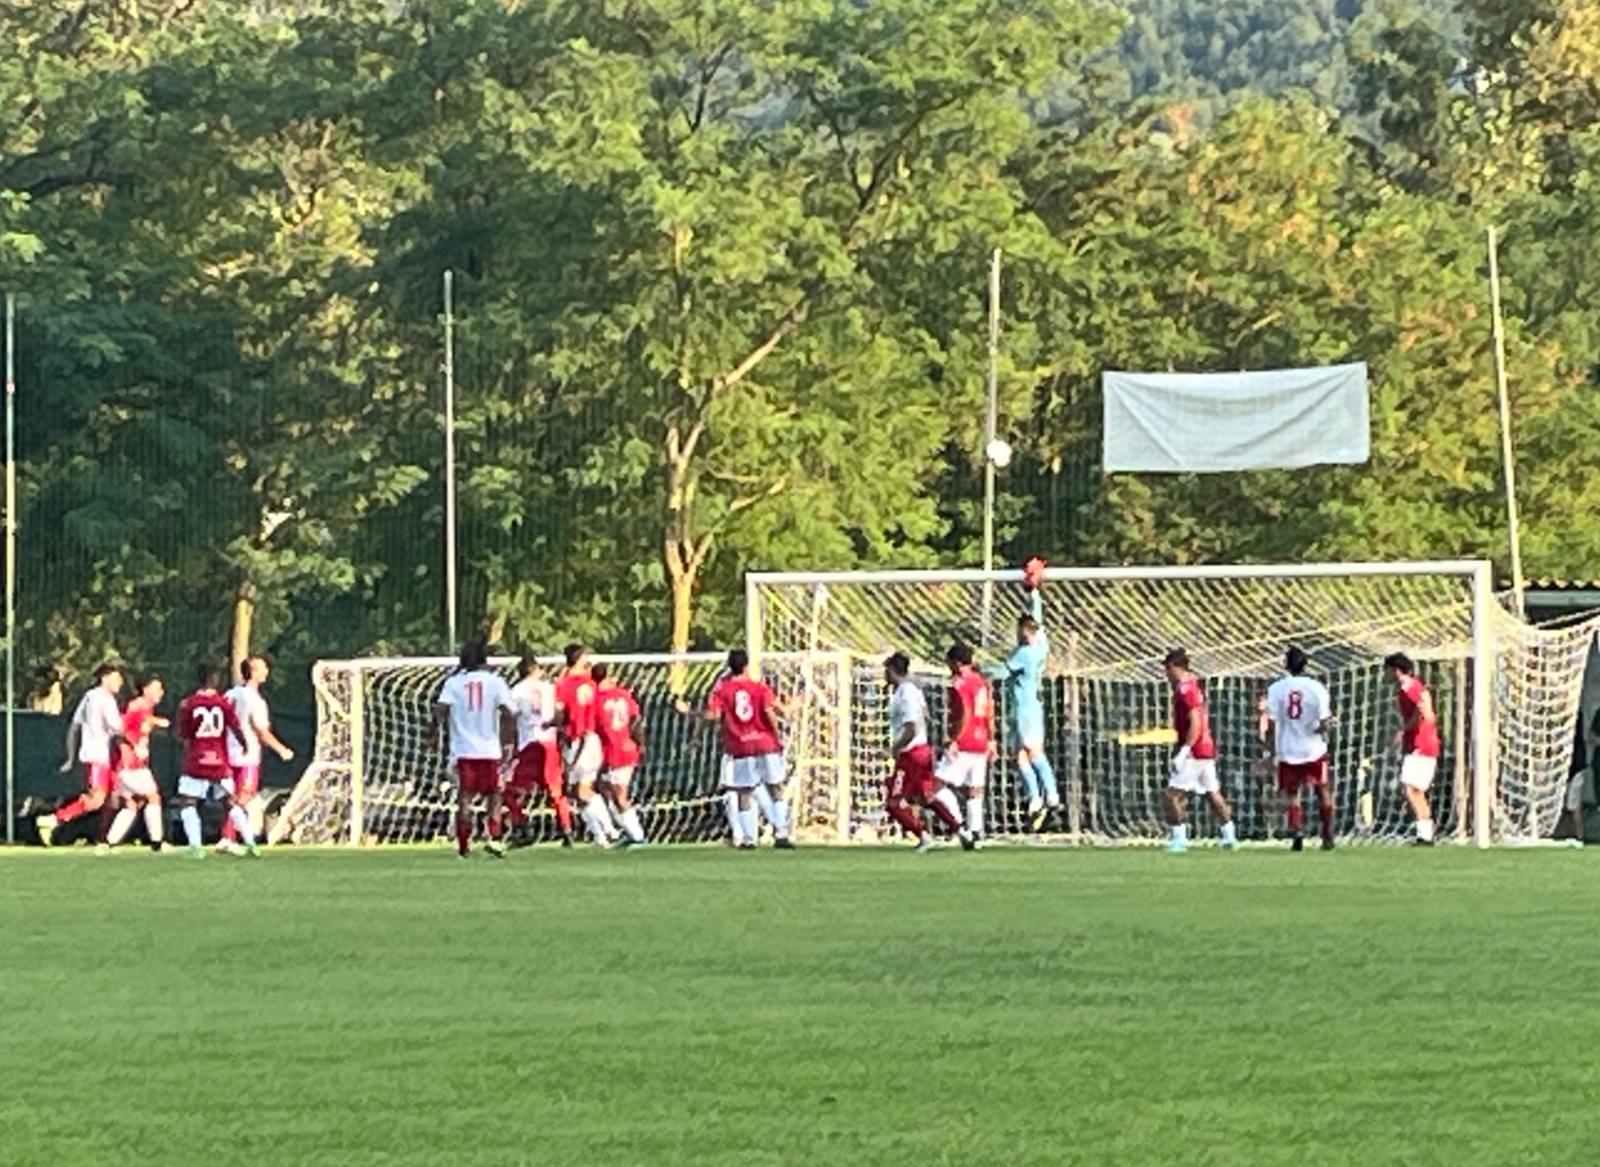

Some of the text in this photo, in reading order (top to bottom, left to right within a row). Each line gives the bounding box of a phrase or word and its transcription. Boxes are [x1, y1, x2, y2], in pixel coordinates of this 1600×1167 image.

[464, 681, 483, 711] 11
[735, 690, 753, 720] 8
[1287, 691, 1303, 719] 8
[193, 706, 224, 738] 20
